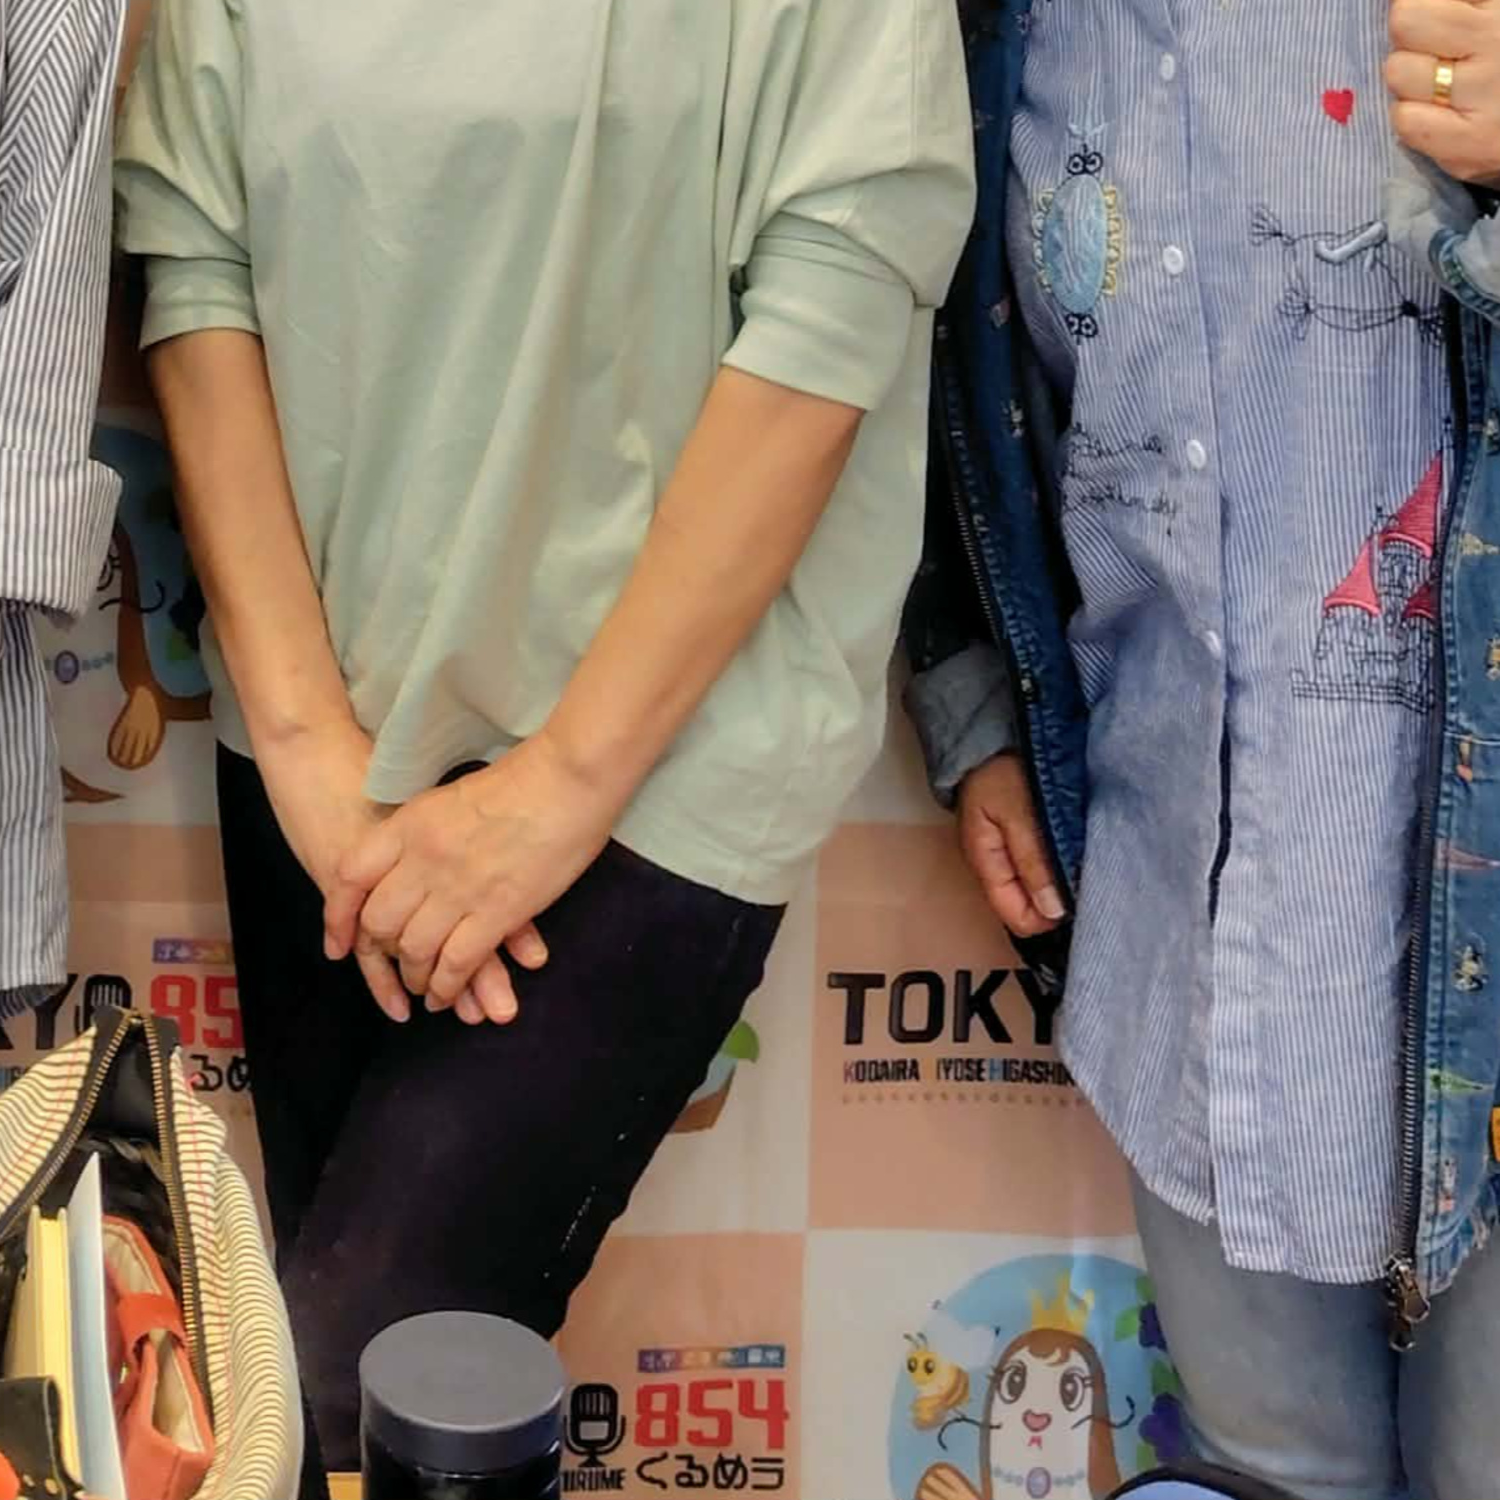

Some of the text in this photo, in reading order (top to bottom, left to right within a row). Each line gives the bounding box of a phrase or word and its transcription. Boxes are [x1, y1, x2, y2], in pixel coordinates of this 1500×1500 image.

[150, 975, 244, 1049] 85
[843, 1058, 920, 1084] KODAIRA
[634, 1379, 790, 1449] 854
